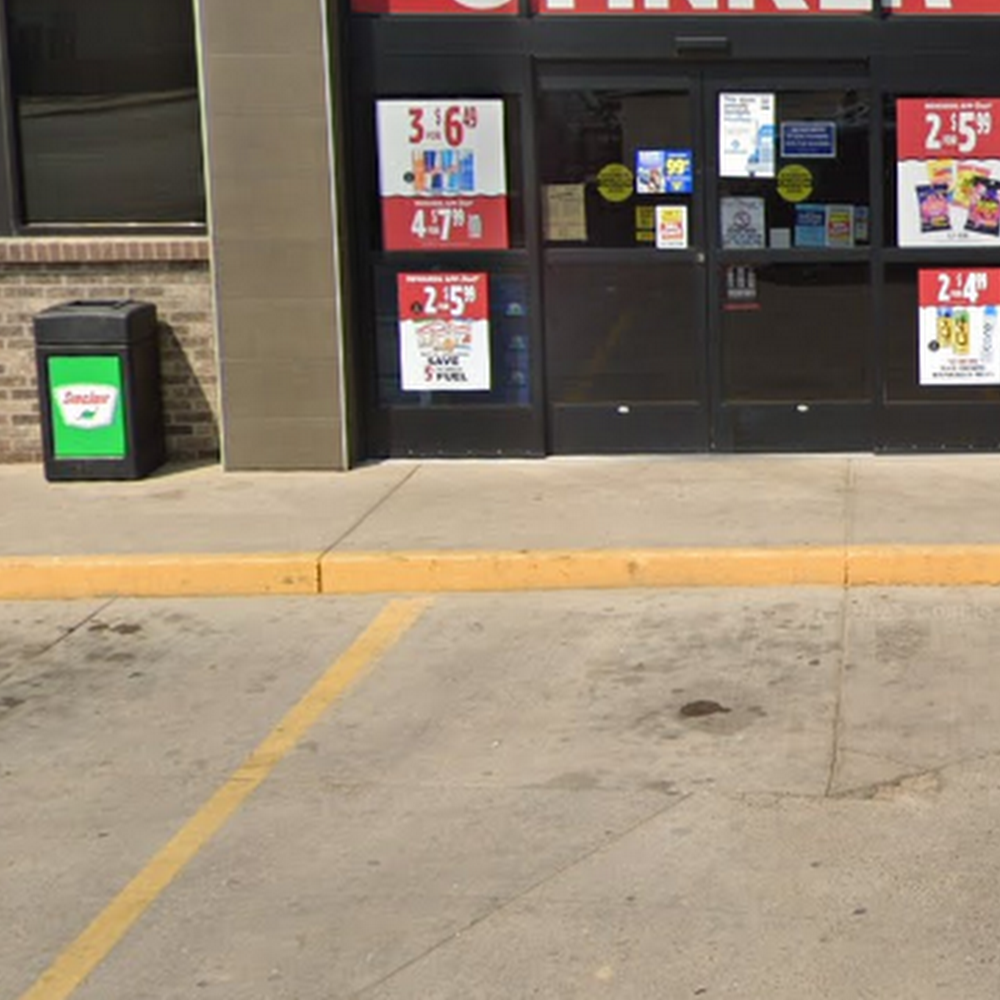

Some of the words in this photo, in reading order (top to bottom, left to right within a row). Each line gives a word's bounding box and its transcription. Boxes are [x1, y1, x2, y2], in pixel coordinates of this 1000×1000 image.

[409, 107, 424, 144] 3
[925, 112, 942, 150] 2
[411, 208, 426, 239] 4
[424, 285, 438, 315] 2
[938, 273, 950, 302] 2
